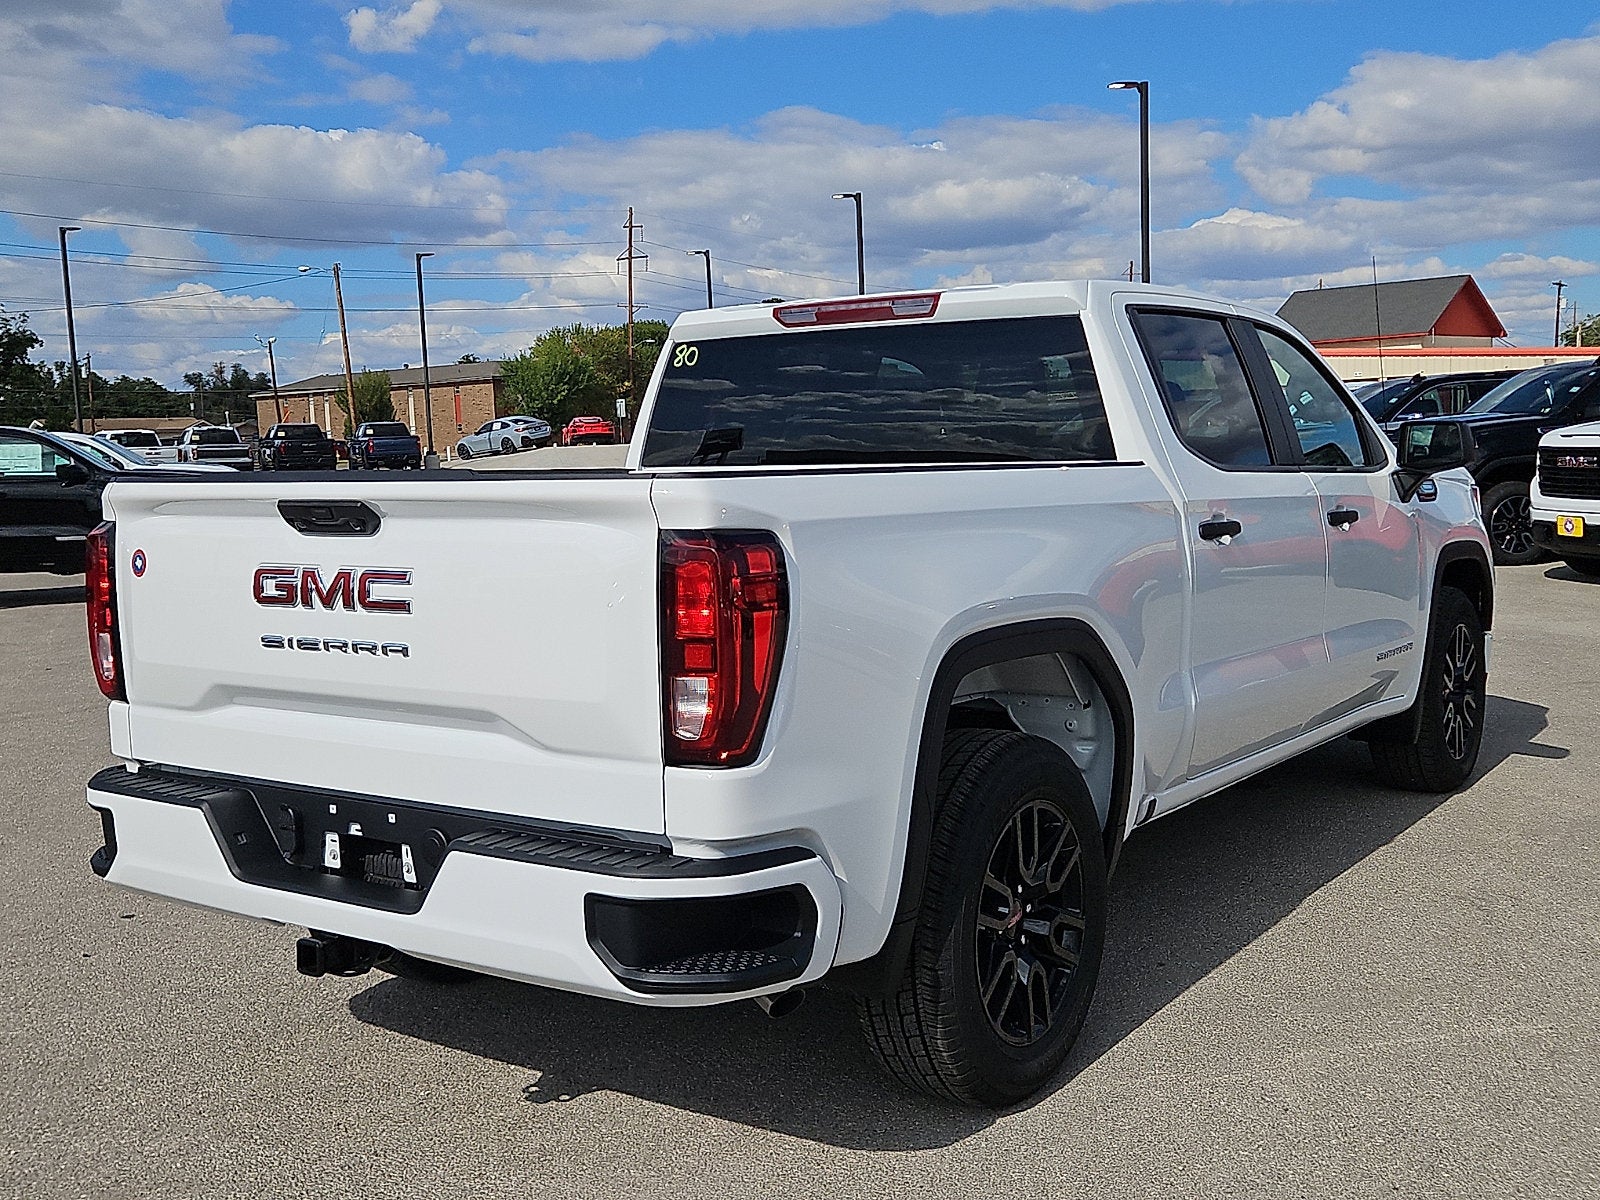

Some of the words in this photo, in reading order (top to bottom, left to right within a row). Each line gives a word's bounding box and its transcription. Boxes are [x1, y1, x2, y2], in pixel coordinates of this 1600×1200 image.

[674, 344, 698, 367] 80
[253, 564, 413, 614] GMC
[260, 635, 410, 658] SIERRA
